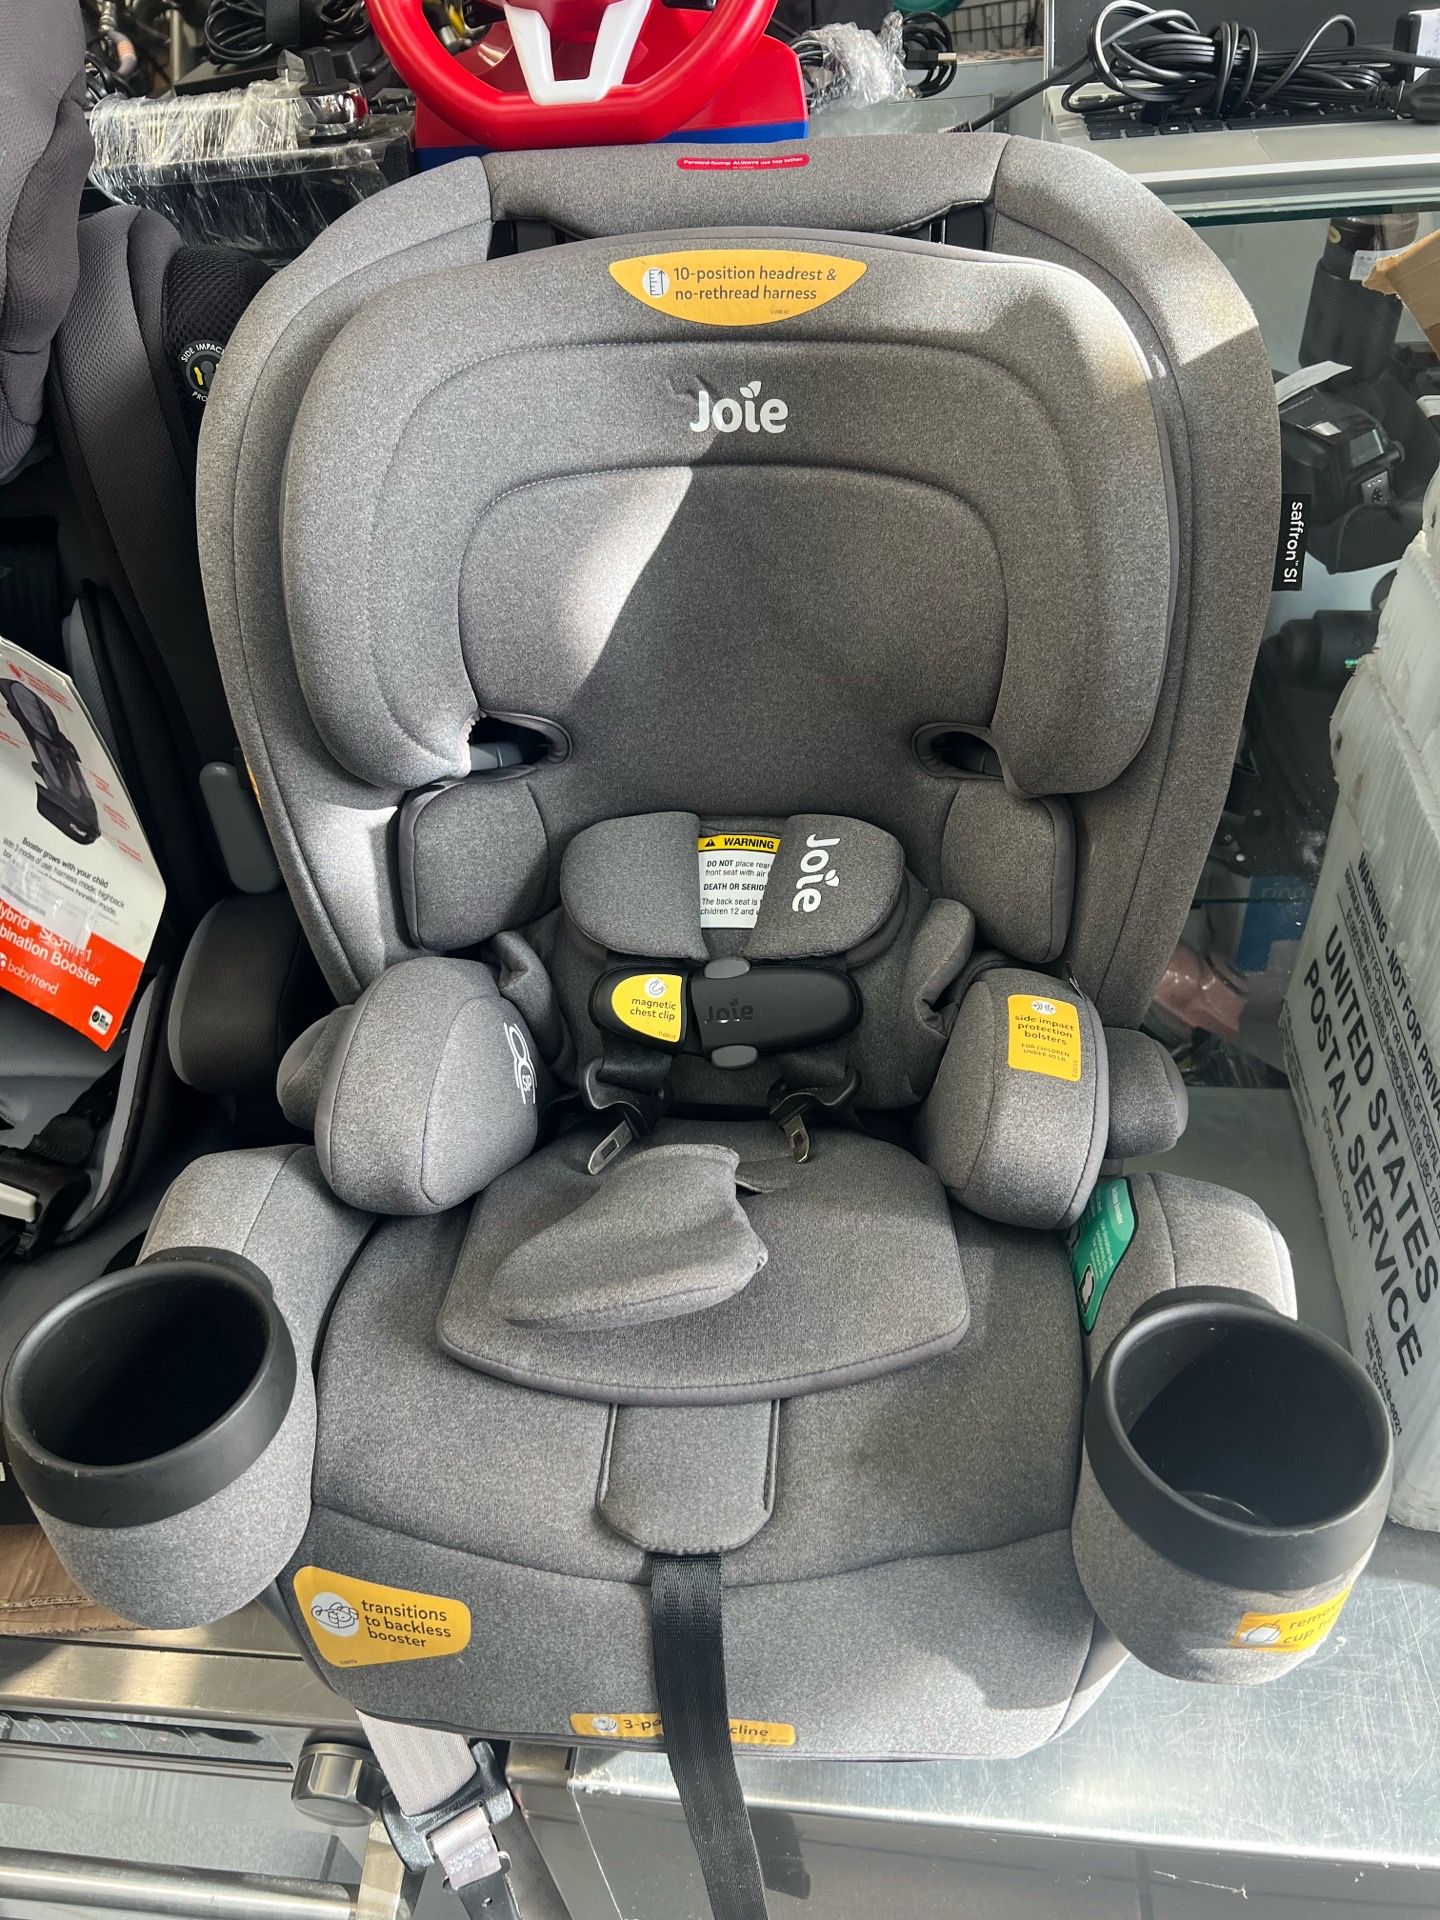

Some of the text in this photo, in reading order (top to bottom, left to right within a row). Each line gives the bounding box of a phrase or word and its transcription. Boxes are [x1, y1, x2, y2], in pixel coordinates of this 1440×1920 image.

[673, 266, 837, 284] 10-position headrest &
[675, 285, 817, 300] no-rethread harness
[181, 347, 196, 363] SIDE
[689, 381, 789, 434] Joie
[1283, 568, 1298, 583] SI
[723, 837, 775, 850] WARNING
[23, 837, 44, 854] Booster
[43, 850, 61, 865] grows
[62, 860, 76, 872] with
[76, 868, 93, 879] your
[92, 876, 109, 889] child
[706, 860, 718, 868] DO
[734, 860, 755, 869] place
[705, 868, 722, 876] front
[739, 869, 755, 877] with
[791, 833, 841, 913] Joie
[703, 883, 728, 891] DEATH
[729, 883, 740, 891] OR
[700, 907, 729, 915] children
[730, 907, 739, 915] 12
[740, 907, 755, 915] and
[1358, 851, 1388, 944] WARNING
[1387, 949, 1407, 998] NOT
[1402, 994, 1422, 1050] FOR
[8, 959, 60, 996] babytrend
[51, 951, 102, 988] Booster
[631, 997, 677, 1011] magnetic
[629, 1007, 676, 1021] chest clip
[1014, 1014, 1075, 1031] side impact
[1017, 1022, 1073, 1038] protection
[1024, 1030, 1067, 1046] bolsters
[1023, 1049, 1047, 1057] UNDER
[1036, 1044, 1070, 1058] CHILDREN
[1325, 924, 1439, 1305] UNITED STATES
[1413, 1093, 1423, 1114] OF
[1420, 1113, 1439, 1174] POSTAL
[1320, 1105, 1334, 1145] FOR
[1331, 1144, 1343, 1192] MAIL
[1303, 958, 1423, 1377] POSTAL SERVICE
[1419, 1150, 1433, 1188] USC
[361, 1600, 448, 1622] transitions
[363, 1614, 452, 1638] to backless
[367, 1627, 427, 1648] booster
[1282, 1628, 1315, 1645] cup
